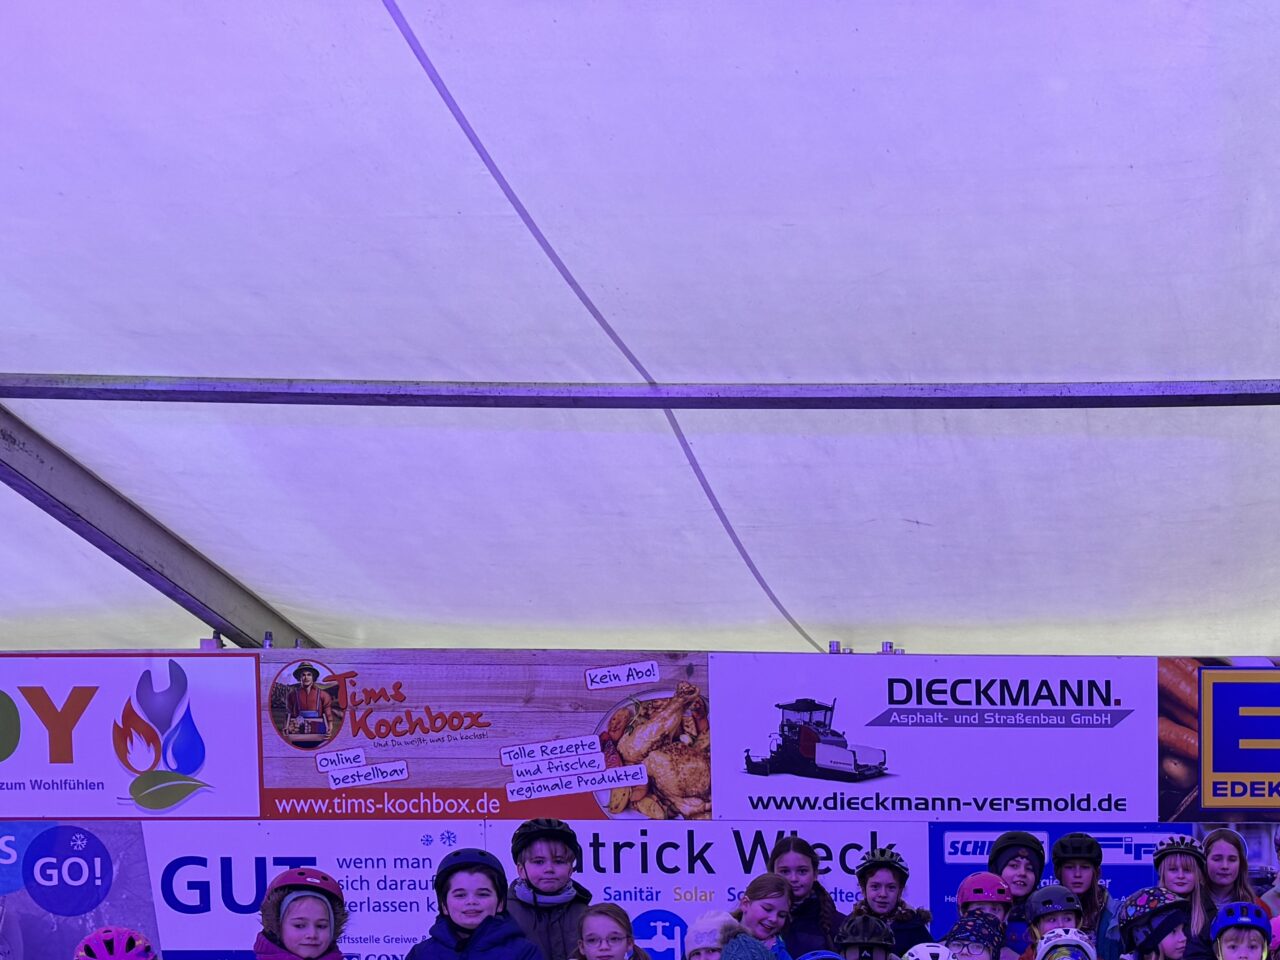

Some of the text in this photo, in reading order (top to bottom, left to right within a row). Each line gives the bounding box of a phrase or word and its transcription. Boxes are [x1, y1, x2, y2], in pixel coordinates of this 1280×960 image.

[588, 664, 656, 686] Kein Abo!
[323, 671, 407, 710] Tims
[887, 678, 1122, 707] DIECKMANN.
[350, 706, 492, 740] Kochbox
[889, 712, 1112, 726] Asphalt- und Straßenbau GmbH
[373, 740, 388, 748] Und
[391, 739, 402, 748] Du
[460, 731, 489, 740] kochst!
[503, 740, 597, 761] Tolle Rezepte
[319, 753, 362, 768] Online
[516, 757, 600, 778] und frische,
[30, 779, 105, 791] Wohlfühlen
[331, 767, 406, 786] bestellbar
[510, 768, 644, 798] regionale Produkte!
[275, 792, 500, 814] www.tims-kochbox.de
[747, 792, 1127, 812] www.dieckmann-versmold.de
[33, 856, 102, 886] GO!
[336, 857, 432, 869] wenn man
[337, 875, 370, 891] sich
[603, 886, 662, 902] Sanitär
[673, 886, 716, 902] Solar
[344, 896, 420, 912] erlassen
[382, 934, 418, 944] Greiwe
